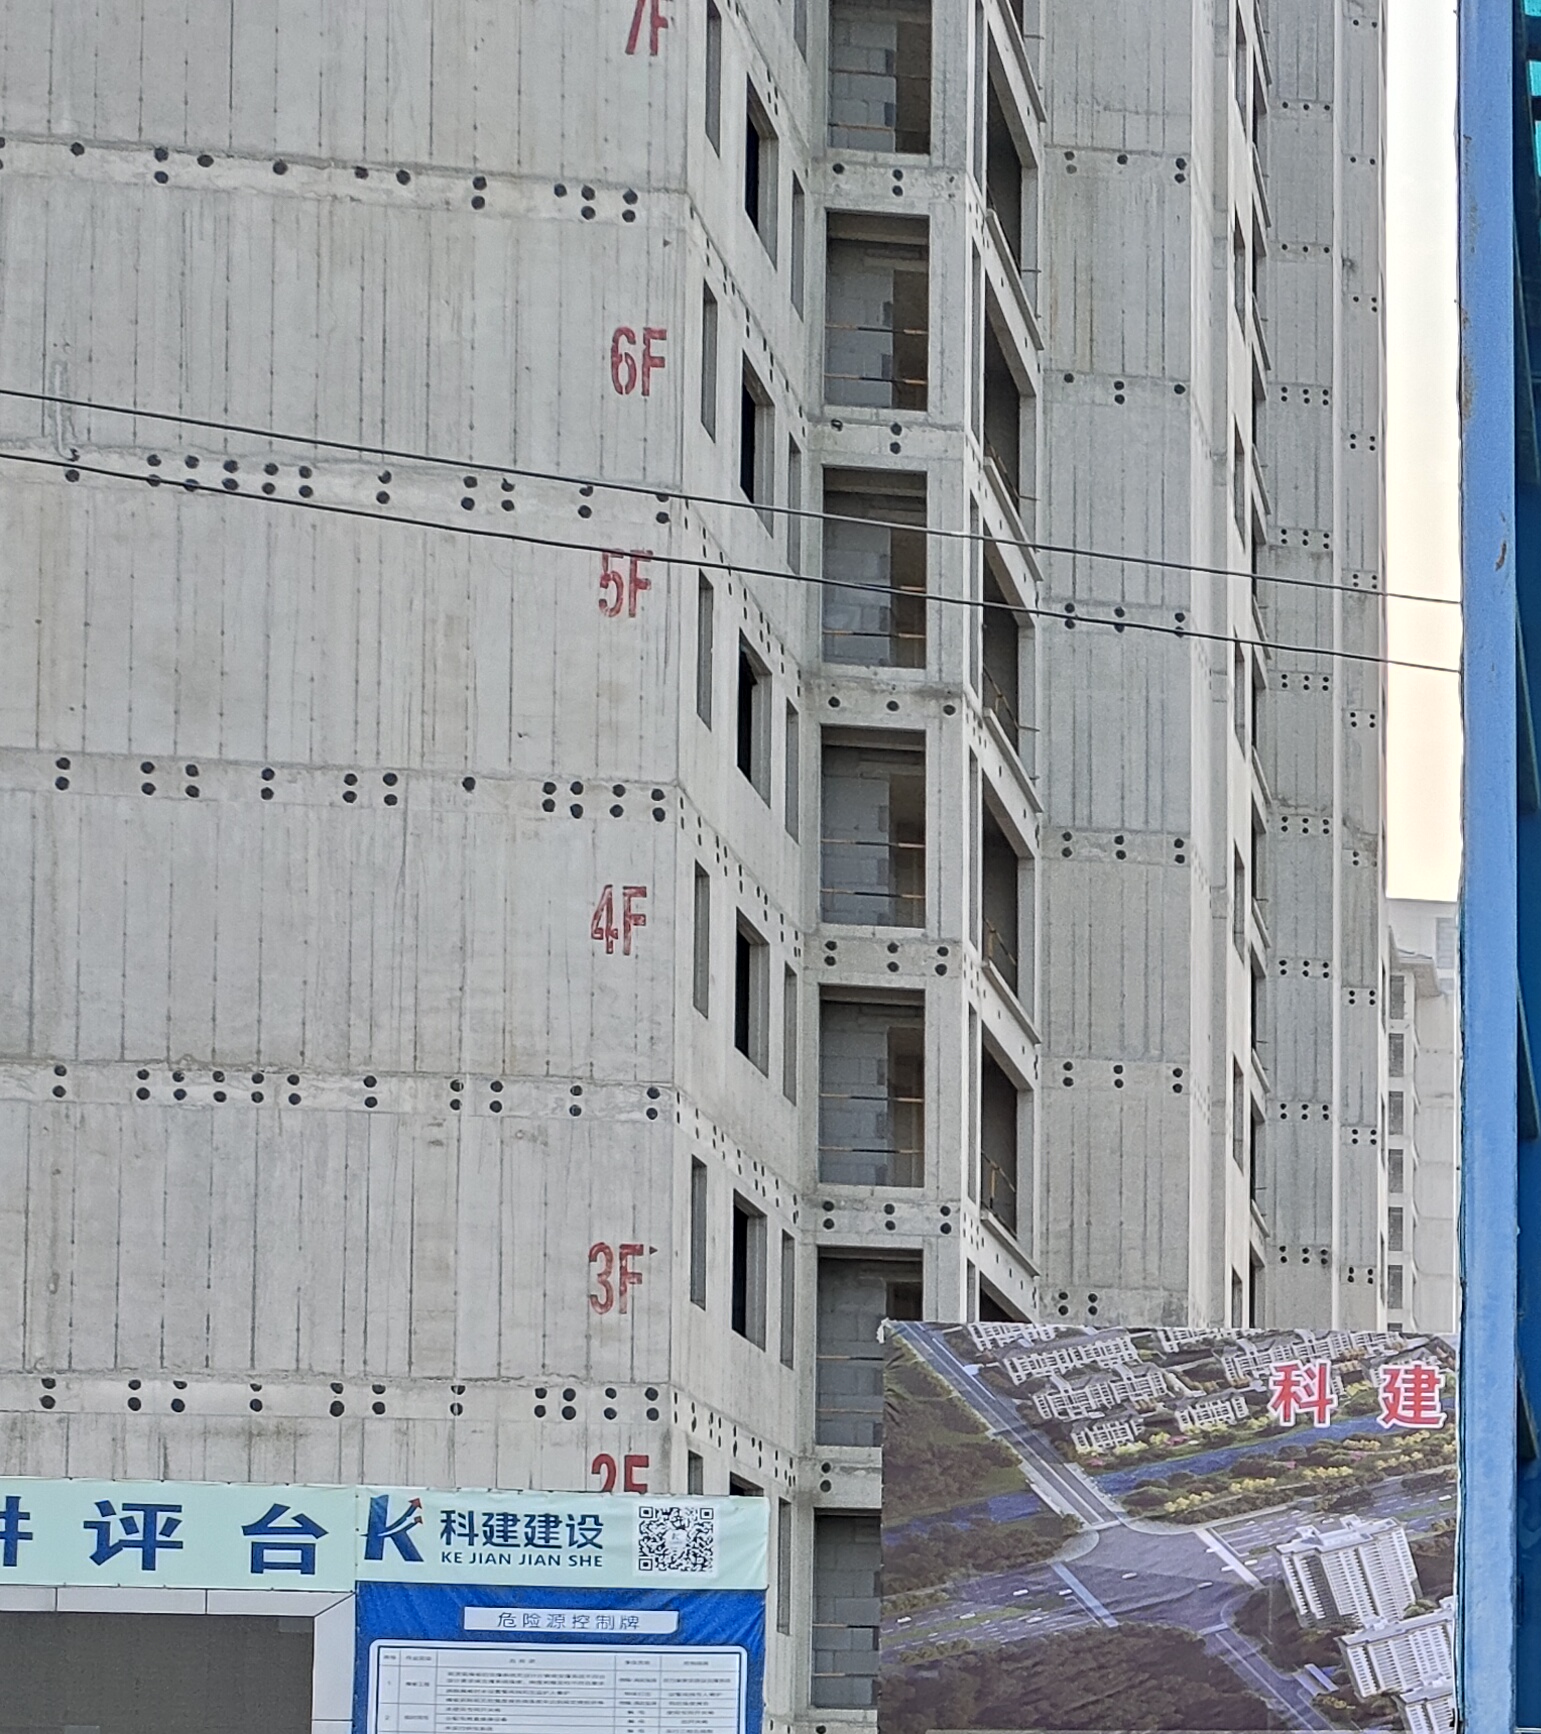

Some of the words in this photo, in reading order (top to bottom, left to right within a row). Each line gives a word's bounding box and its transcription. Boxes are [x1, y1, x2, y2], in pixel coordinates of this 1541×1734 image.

[625, 0, 669, 56] 7F
[610, 326, 668, 398] 6F
[597, 549, 654, 619] 5F
[589, 885, 648, 957] 4F
[587, 1243, 645, 1316] 3F
[440, 1509, 604, 1550] 科建建设
[440, 1551, 463, 1565] KE
[468, 1551, 512, 1567] JIAN
[518, 1552, 561, 1568] JIAN
[567, 1553, 604, 1568] SHE
[496, 1610, 641, 1632] 危险源控制牌
